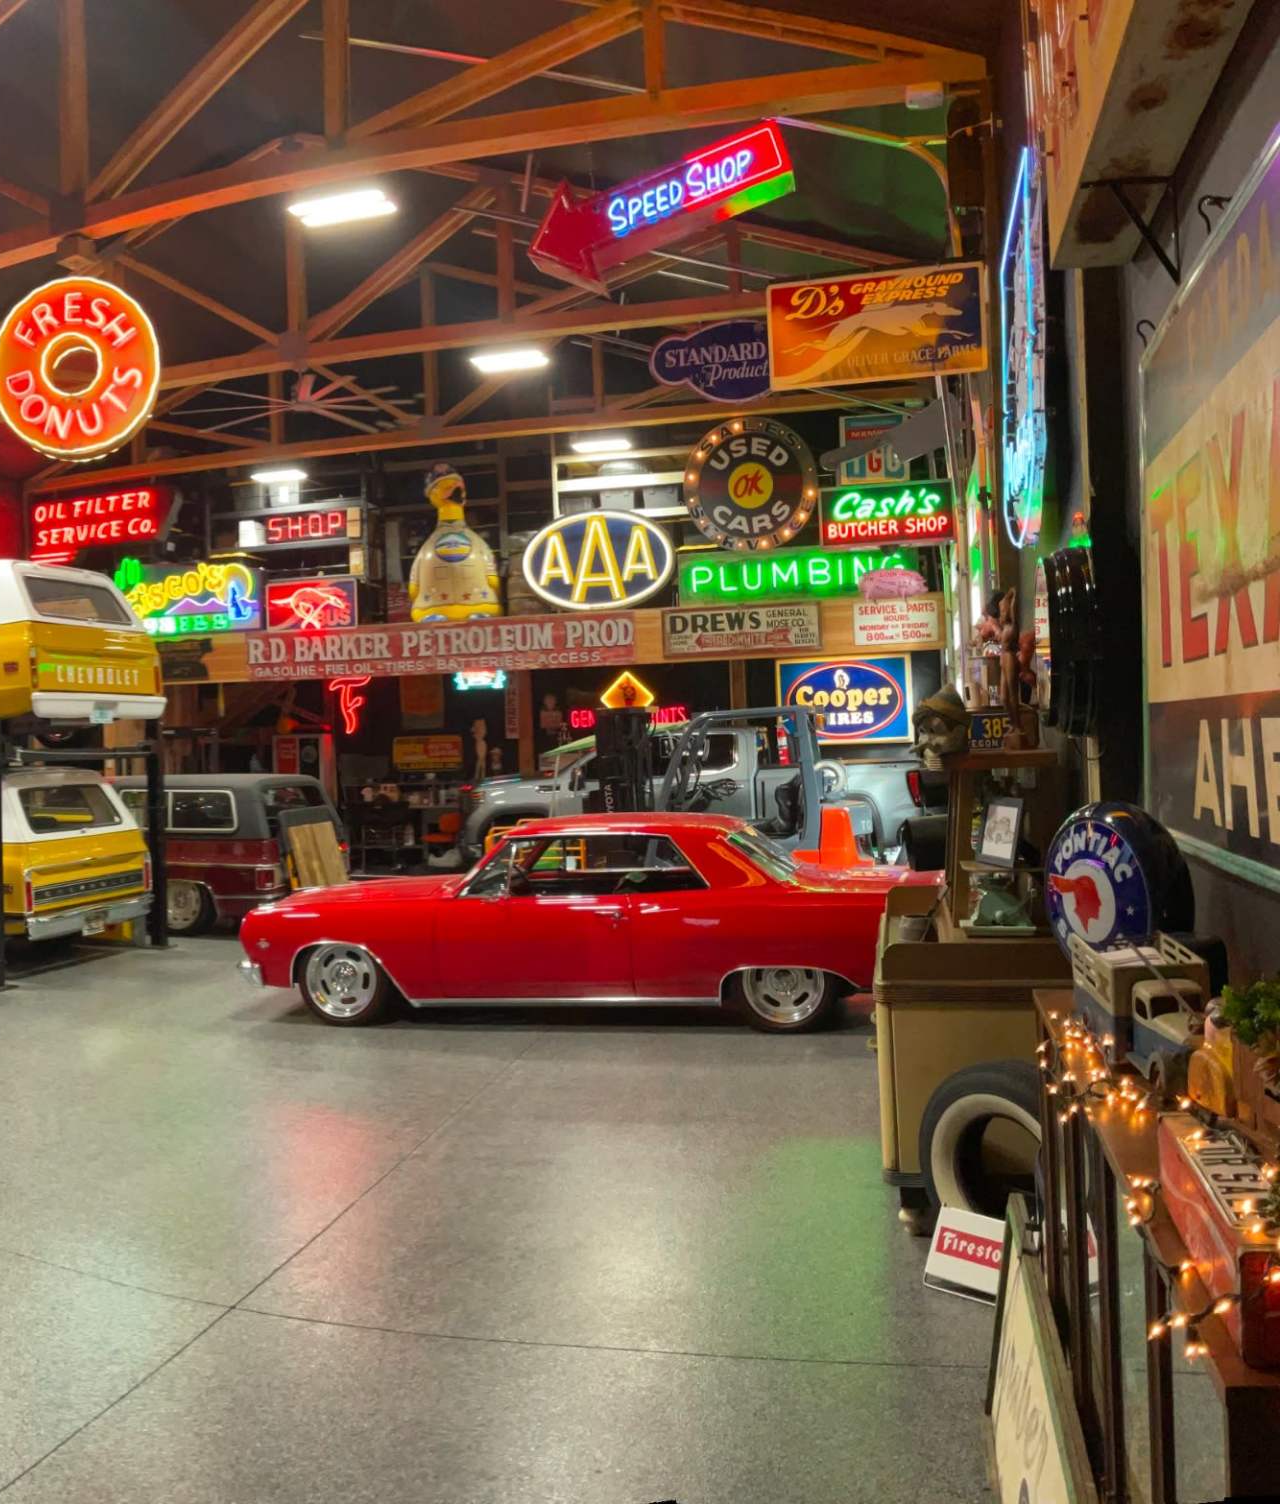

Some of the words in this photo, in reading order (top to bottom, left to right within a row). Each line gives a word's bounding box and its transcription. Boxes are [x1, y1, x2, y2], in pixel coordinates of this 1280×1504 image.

[608, 180, 683, 233] SPEED
[685, 149, 753, 198] SHOP
[785, 285, 845, 321] D's
[860, 285, 949, 306] EXPRESS
[14, 292, 136, 347] FRESH
[665, 341, 767, 369] STANDARD
[847, 350, 889, 369] OLIVER
[893, 346, 936, 364] GRACE
[704, 359, 769, 388] Product
[6, 366, 143, 440] DONUTS
[709, 437, 789, 471] USED
[35, 501, 66, 523] OIL
[73, 490, 151, 518] FILTER
[712, 500, 791, 534] CARS
[833, 488, 941, 521] Cash's
[36, 519, 124, 547] SERVICE
[267, 513, 344, 543] SHOP
[827, 519, 899, 540] BUTCHER
[904, 515, 948, 534] SHOP
[540, 515, 658, 602] AAA
[766, 607, 809, 618] GENERAL
[858, 604, 897, 616] SERVICE
[906, 602, 935, 613] PARTS
[293, 632, 391, 662] BARKER
[401, 621, 554, 658] PETROLEUM
[56, 664, 139, 687] CHEVROLET
[255, 664, 316, 678] GASOLINE
[325, 662, 352, 676] FUEL
[353, 662, 375, 674] OIL
[384, 660, 425, 673] TIRES
[436, 653, 525, 671] BATTERIES
[795, 686, 893, 712] Cooper
[827, 711, 875, 726] IRES
[603, 784, 614, 813] YOTA
[1054, 829, 1134, 883] PONTIAC
[943, 1230, 1002, 1263] Firesto
